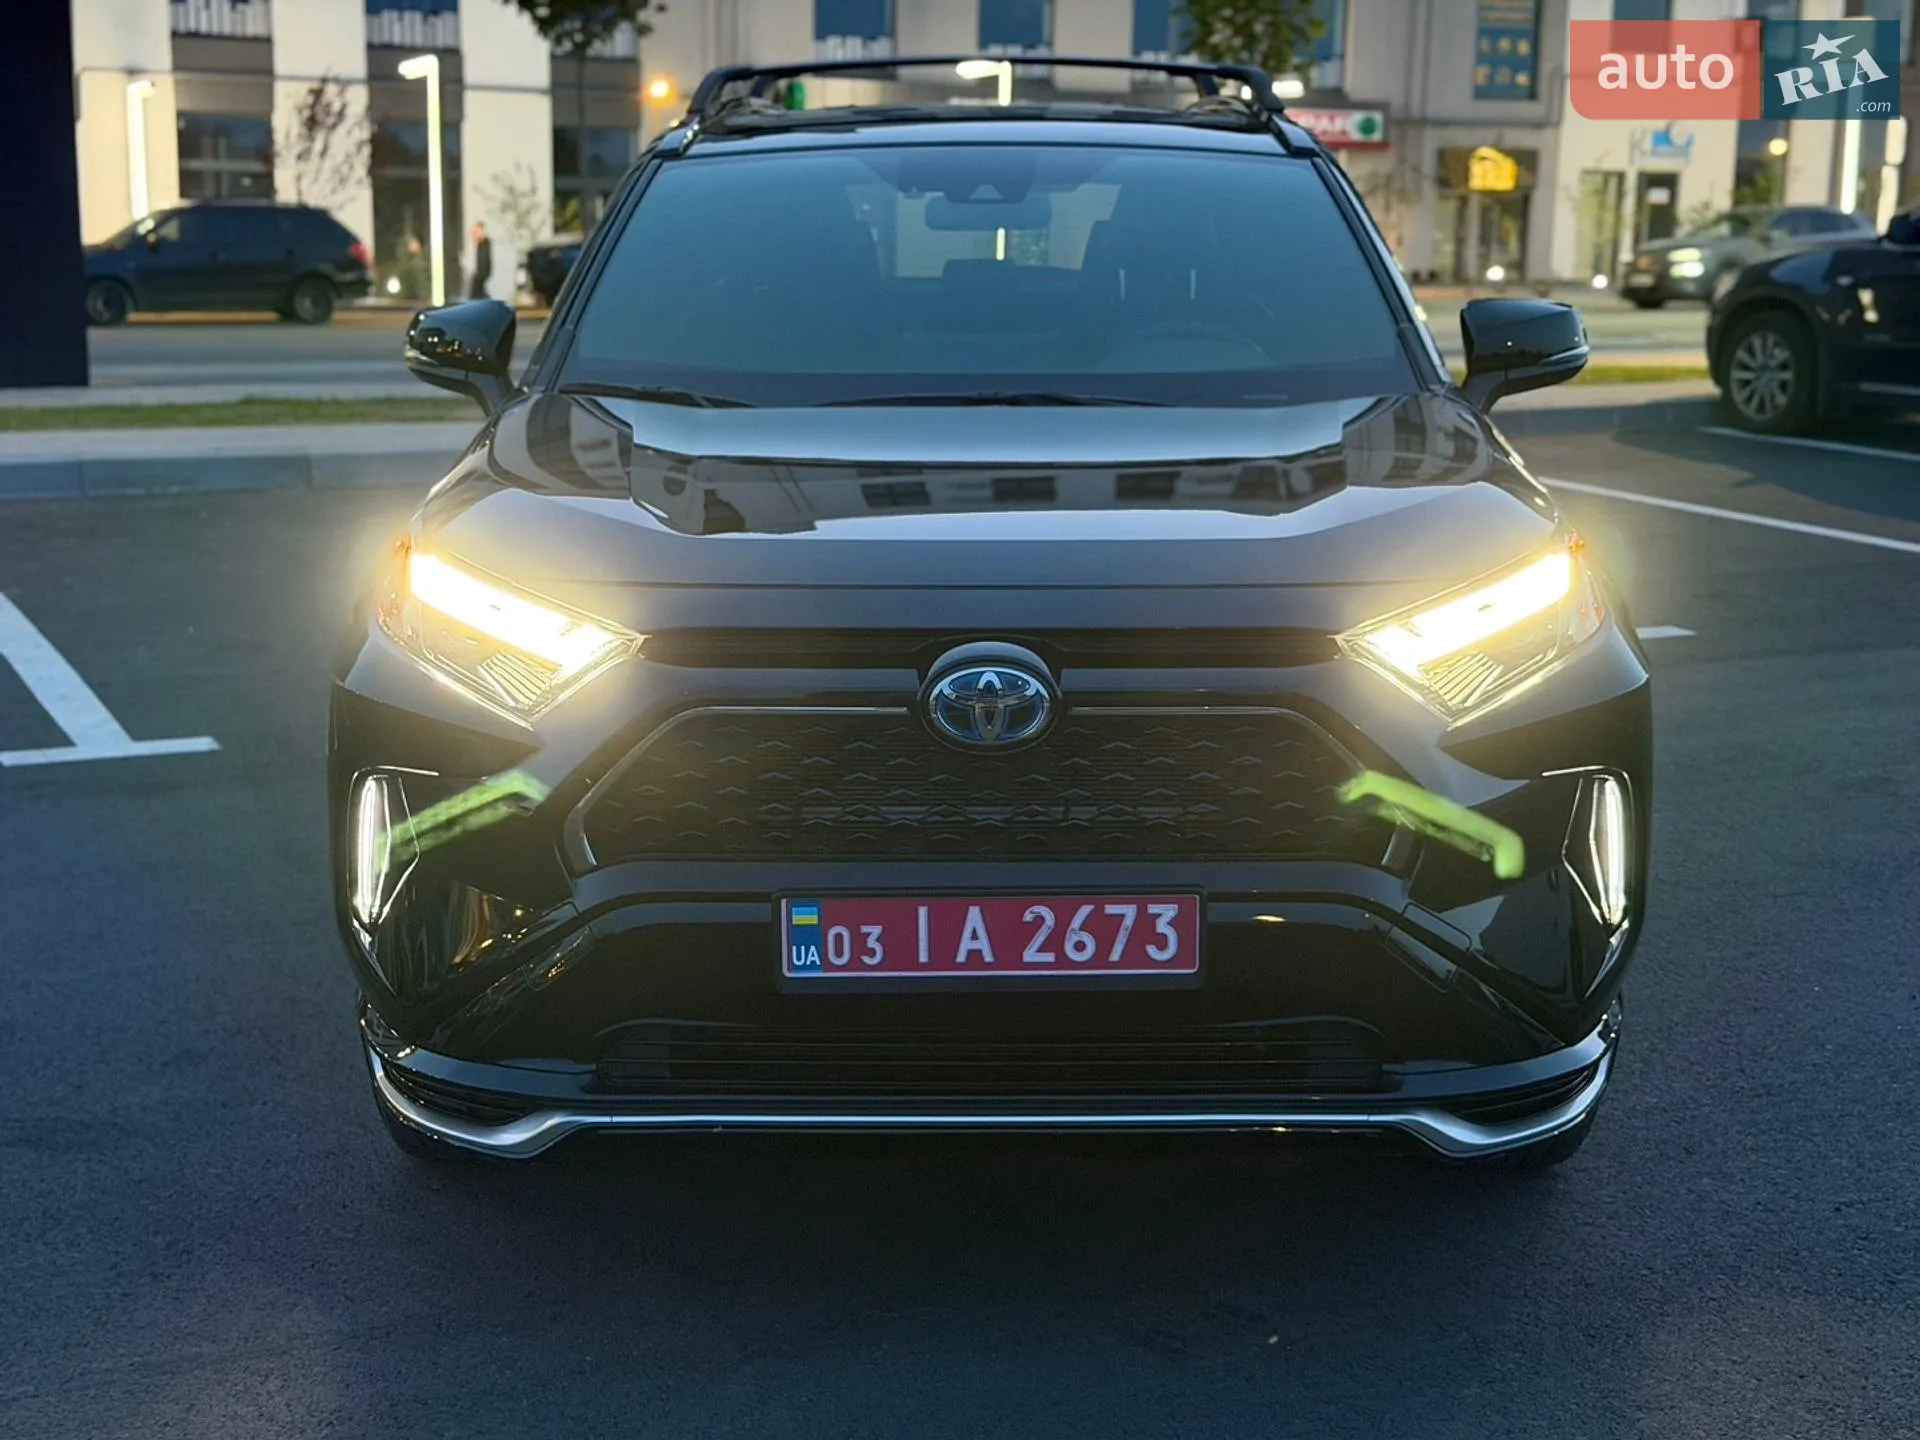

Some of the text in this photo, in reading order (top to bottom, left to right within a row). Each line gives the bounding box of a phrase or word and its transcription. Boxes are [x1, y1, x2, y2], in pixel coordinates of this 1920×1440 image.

[792, 945, 821, 966] UA
[827, 925, 884, 966] 03
[1021, 904, 1180, 963] 2673
